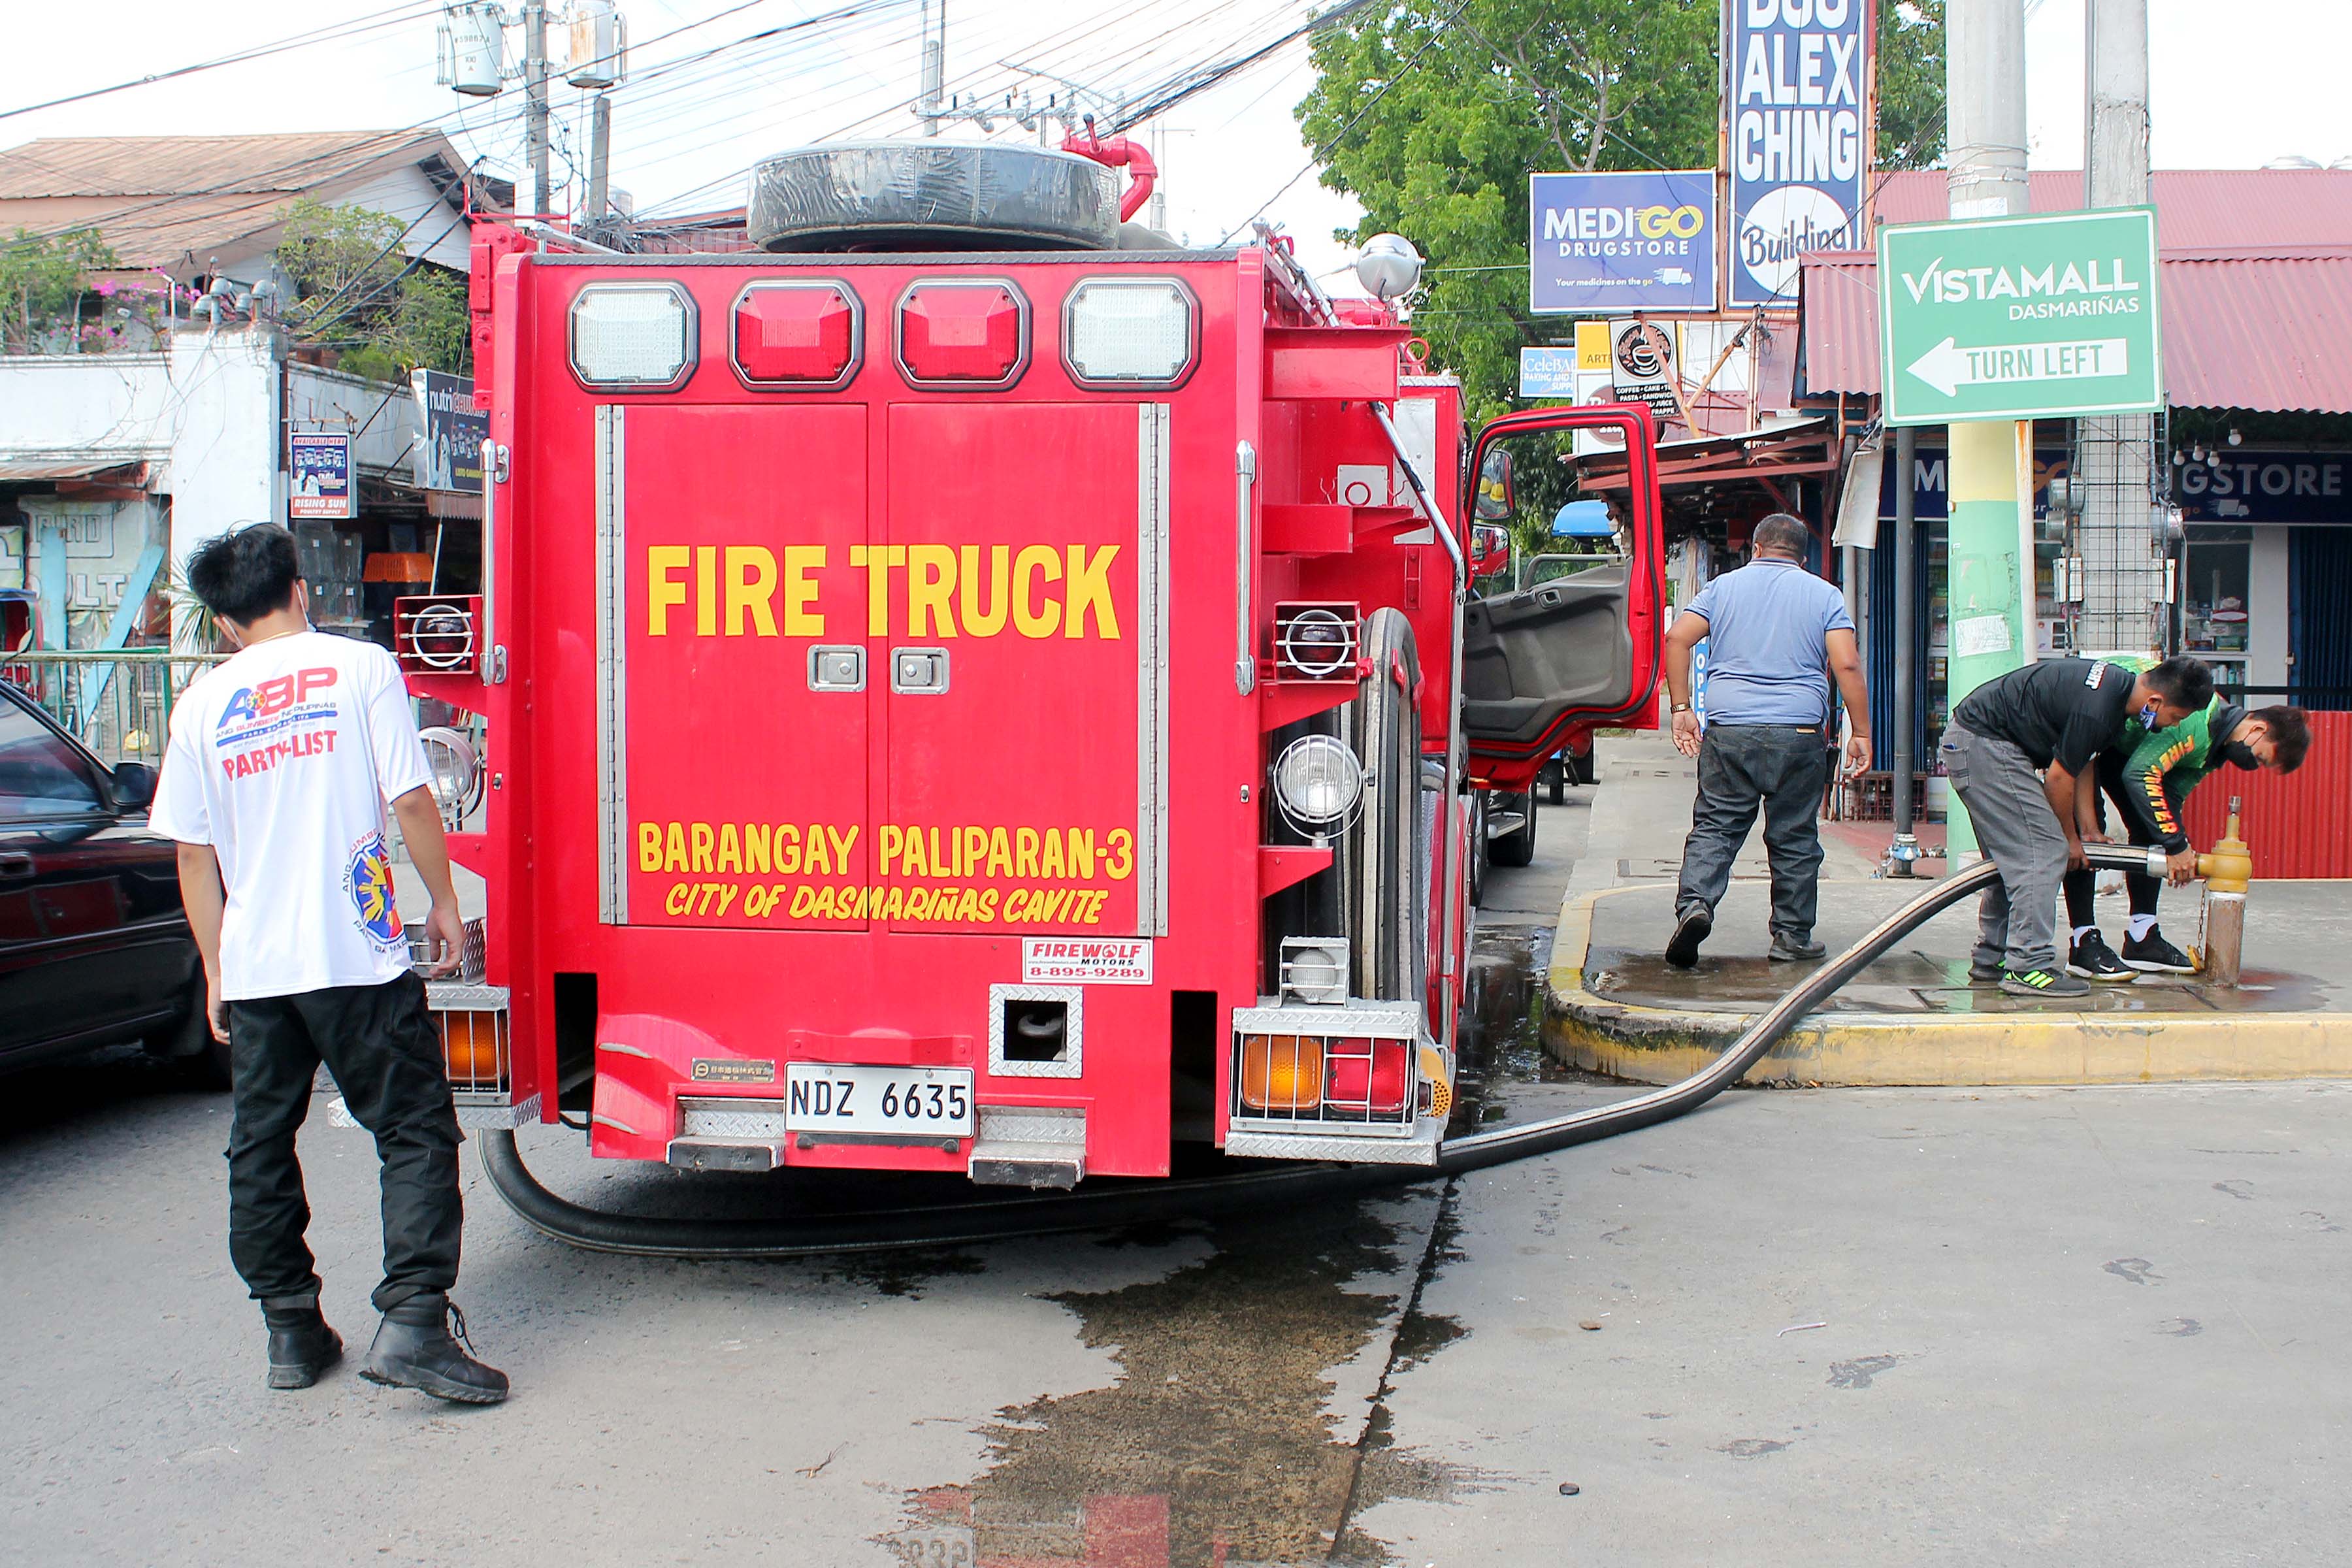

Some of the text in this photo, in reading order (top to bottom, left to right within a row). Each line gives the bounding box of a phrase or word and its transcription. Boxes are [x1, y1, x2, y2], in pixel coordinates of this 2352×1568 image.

[1739, 33, 1857, 106] ALEX
[1738, 110, 1857, 183] CHING
[1560, 240, 1689, 257] DRUGSTORE
[1742, 215, 1846, 267] Building
[1556, 278, 1575, 287] Your
[1576, 277, 1615, 286] medicines
[1628, 277, 1641, 286] the
[1901, 256, 2138, 304] VISTAMALL
[2008, 295, 2140, 321] DASMARIÑAS
[1524, 356, 1576, 372] CeleBA
[1552, 372, 1569, 382] AND
[1967, 344, 2103, 380] TURN LEFT
[293, 437, 346, 446] AVAILABLE HERE
[294, 498, 347, 508] RISING SUN
[648, 544, 1121, 640] FIRE TRUCK
[216, 667, 338, 730] ABP
[294, 702, 336, 713] PILIPINAS
[1696, 653, 1706, 728] OPEN
[222, 730, 338, 782] PARTY-LIST
[2159, 734, 2195, 772] FIRE
[638, 821, 1134, 880] BARANGAY PALIPARAN-3
[665, 883, 1109, 924] CITY OF DASMARIÑAS CAVITE
[1032, 943, 1142, 958] FIREWOLF
[1030, 967, 1145, 977] 8-895-9289
[791, 1080, 966, 1120] NDZ 6635
